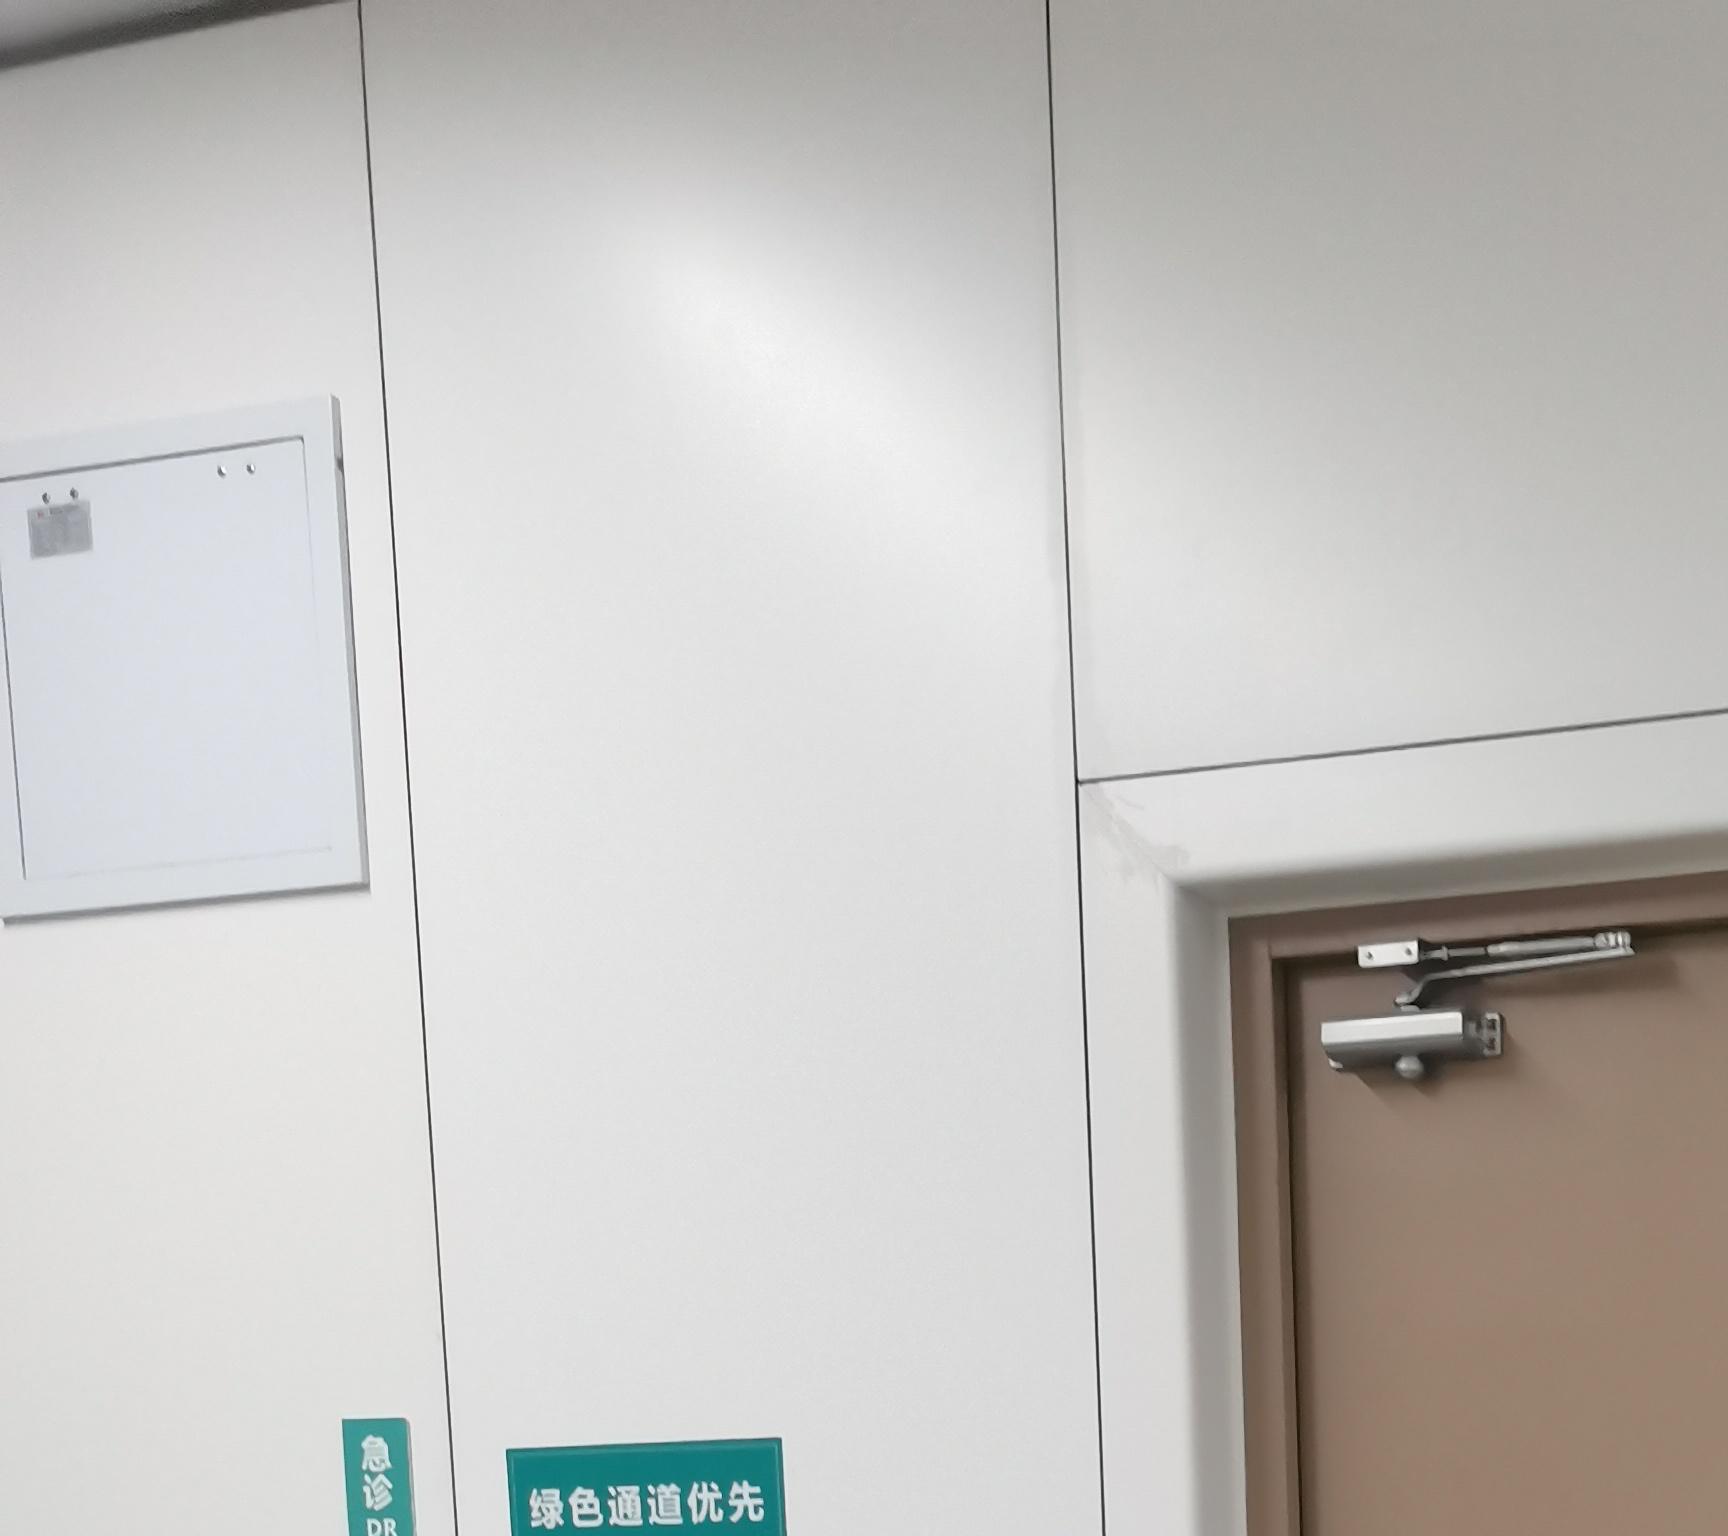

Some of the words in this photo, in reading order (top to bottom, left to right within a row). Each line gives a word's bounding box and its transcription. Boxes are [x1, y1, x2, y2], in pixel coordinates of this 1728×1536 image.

[528, 1480, 765, 1531] 绿色通道优先
